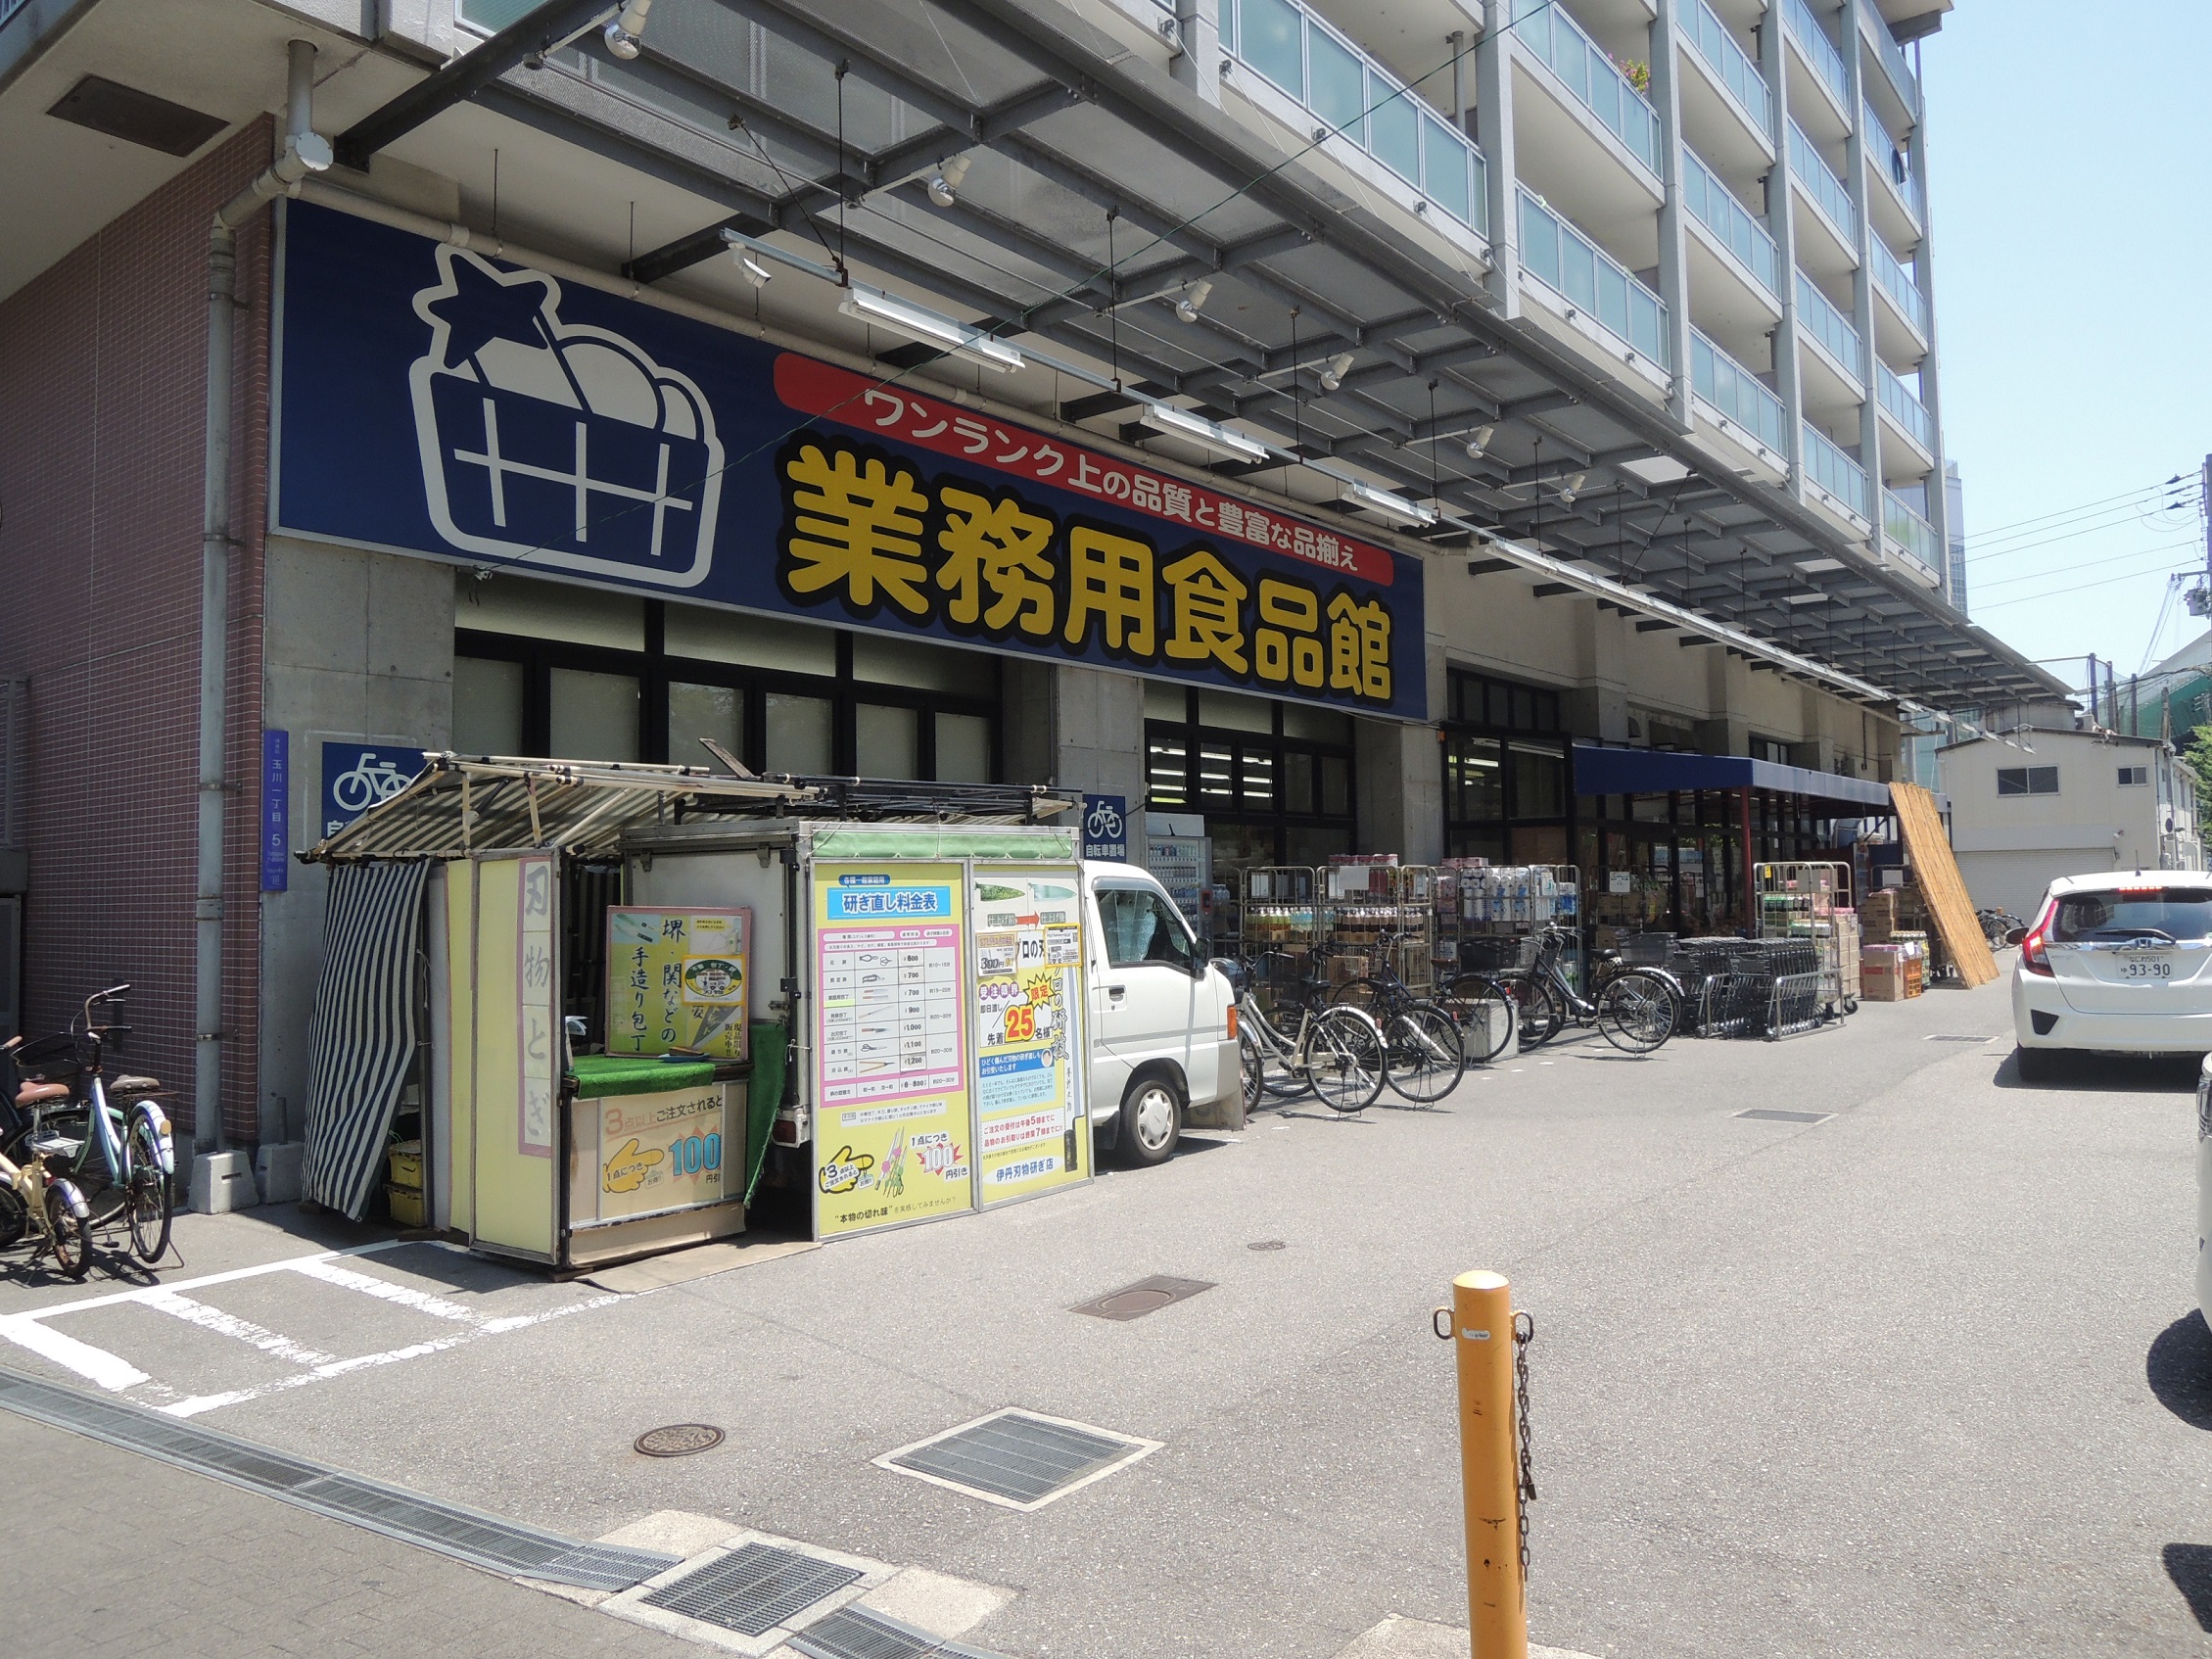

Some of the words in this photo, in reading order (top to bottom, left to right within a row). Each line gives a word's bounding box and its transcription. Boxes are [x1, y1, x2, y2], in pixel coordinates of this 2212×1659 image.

[864, 388, 1358, 572] ワンランク上の品質と豊富な品揃え
[786, 443, 1392, 700] 業務用食品館
[271, 759, 282, 823] 玉川一丁目
[1085, 843, 1125, 858] 自転車置場
[843, 892, 937, 913] 研ぎ直し料金表
[2129, 963, 2171, 976] 93-90
[525, 865, 550, 1137] 刃物とぎ
[630, 946, 650, 1052] 手造り包丁
[1030, 984, 1049, 1001] 限定
[911, 1132, 949, 1147] 1点につき
[668, 1132, 722, 1177] 100
[922, 1144, 955, 1172] 100
[945, 1166, 968, 1180] 円引き
[996, 1158, 1055, 1182] 伊丹刃物研ぎ店
